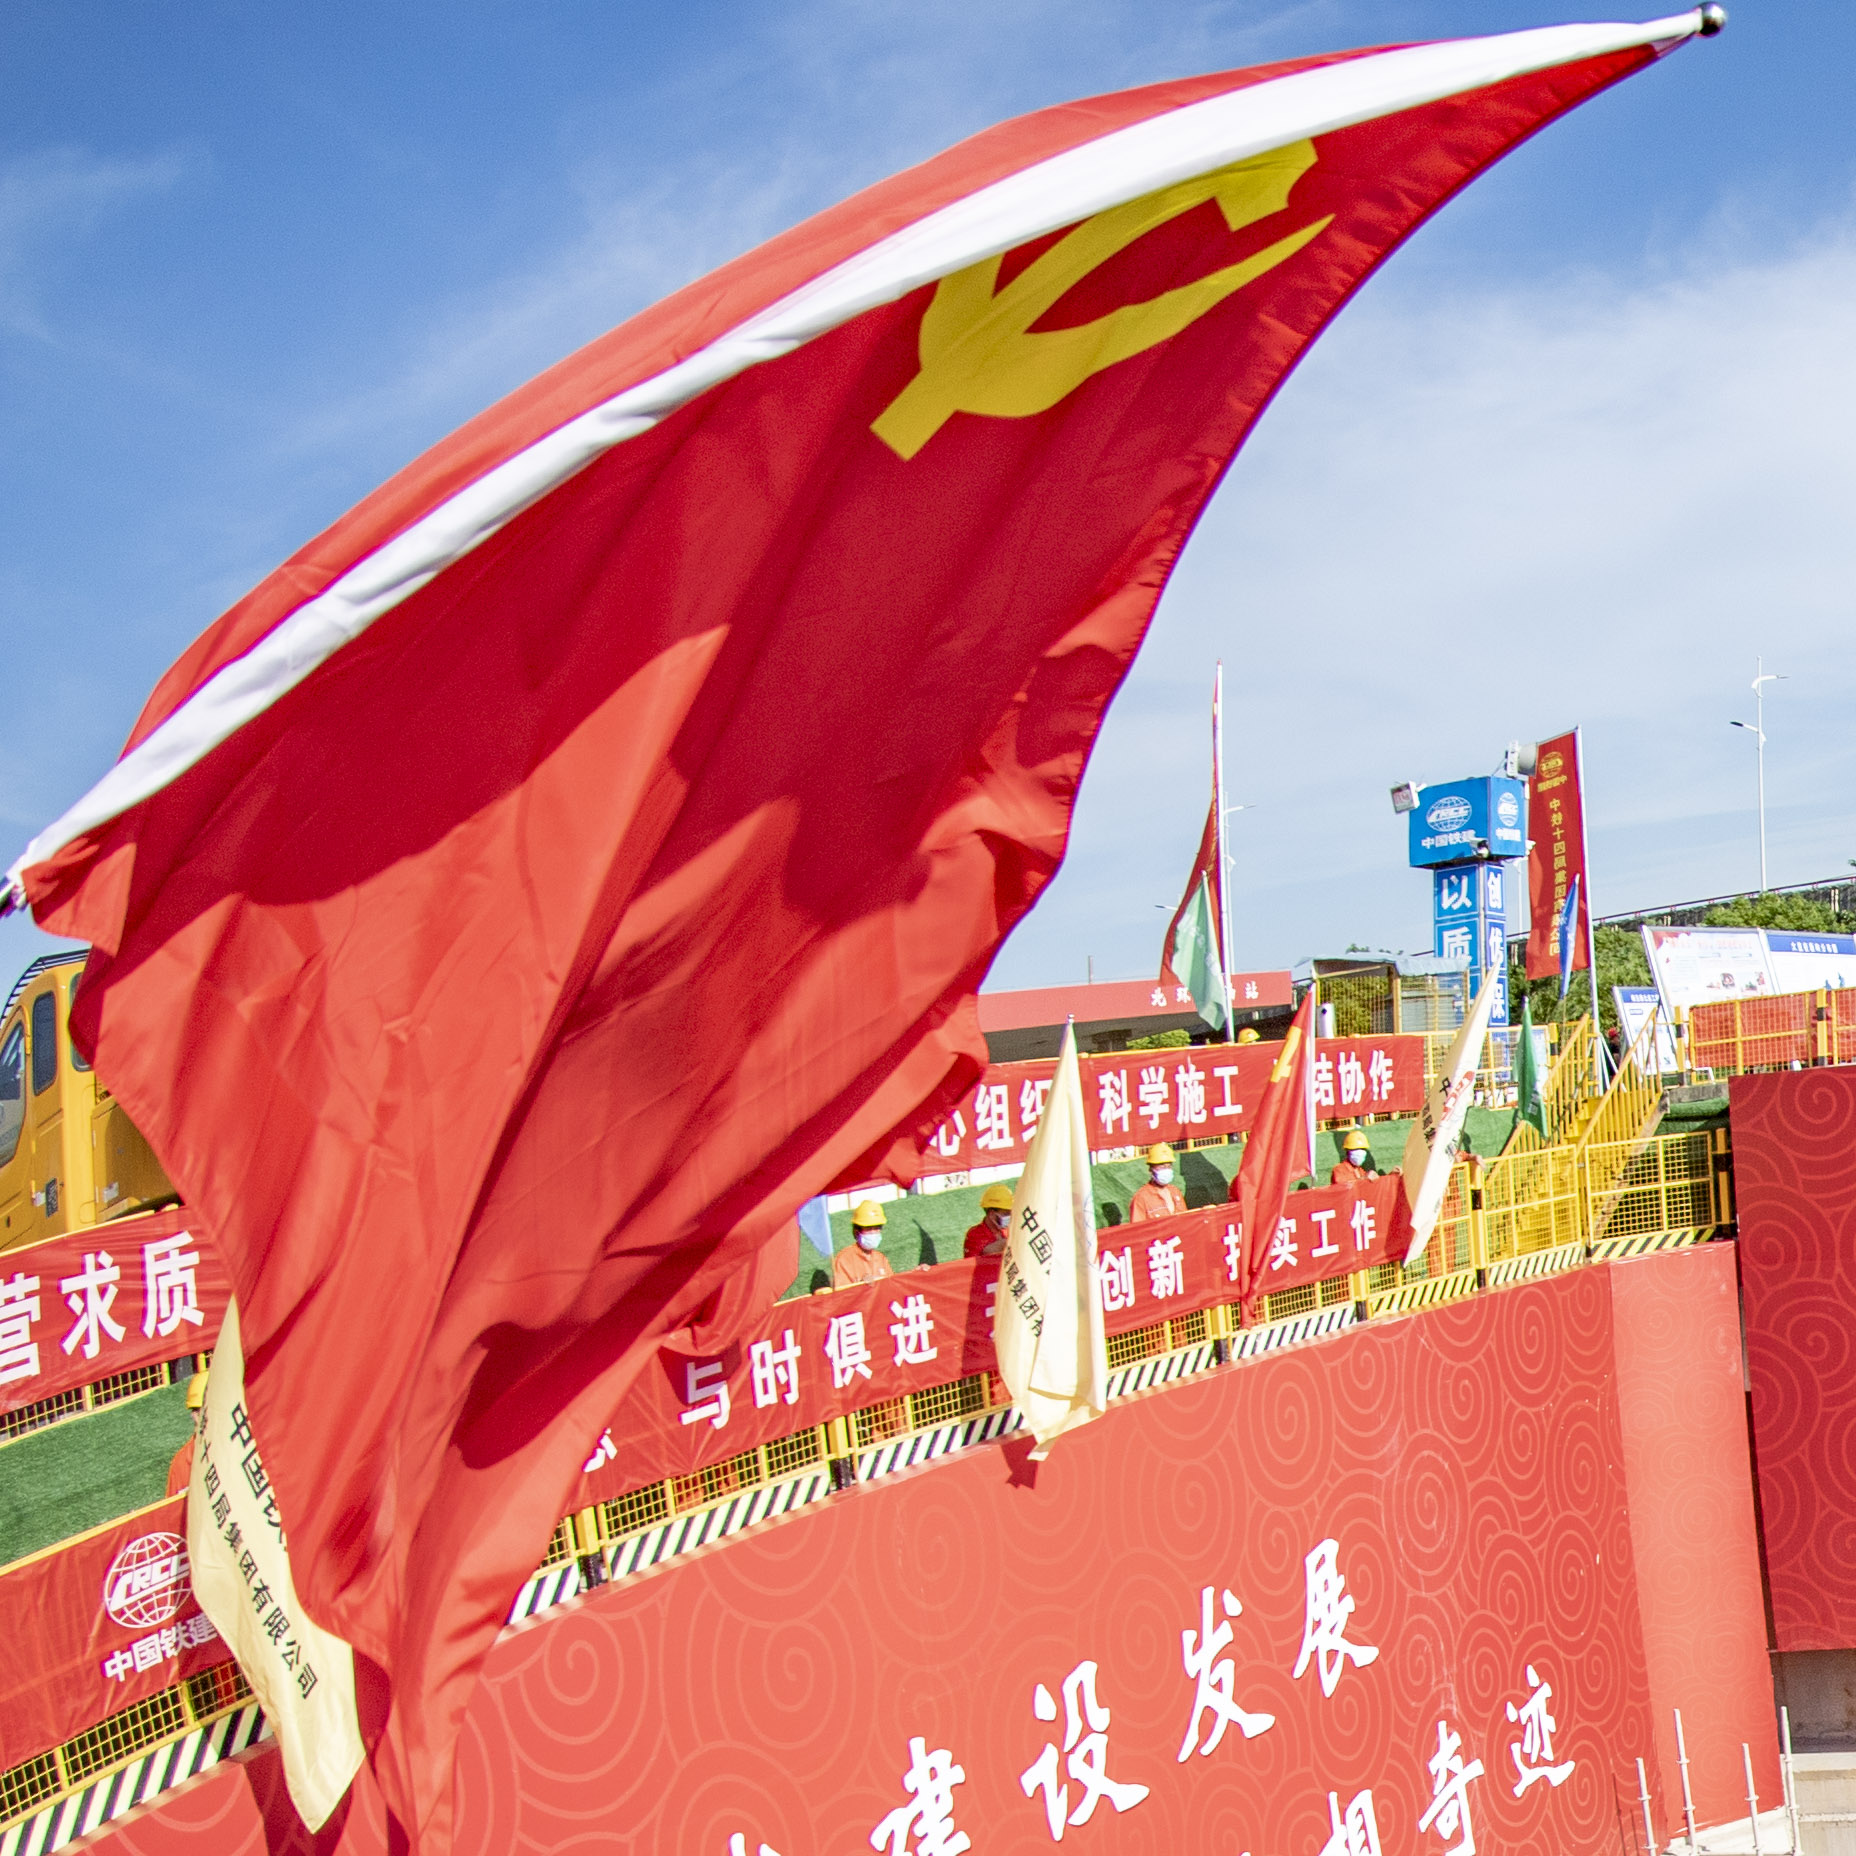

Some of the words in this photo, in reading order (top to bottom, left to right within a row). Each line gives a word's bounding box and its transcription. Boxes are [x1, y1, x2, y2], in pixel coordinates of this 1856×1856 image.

[1100, 1066, 1243, 1135] 科学施工
[1312, 1050, 1395, 1108] 结协作
[0, 1231, 204, 1383] 营求质
[678, 1294, 938, 1430] 与时俱进
[103, 1611, 218, 1682] 中国铁建
